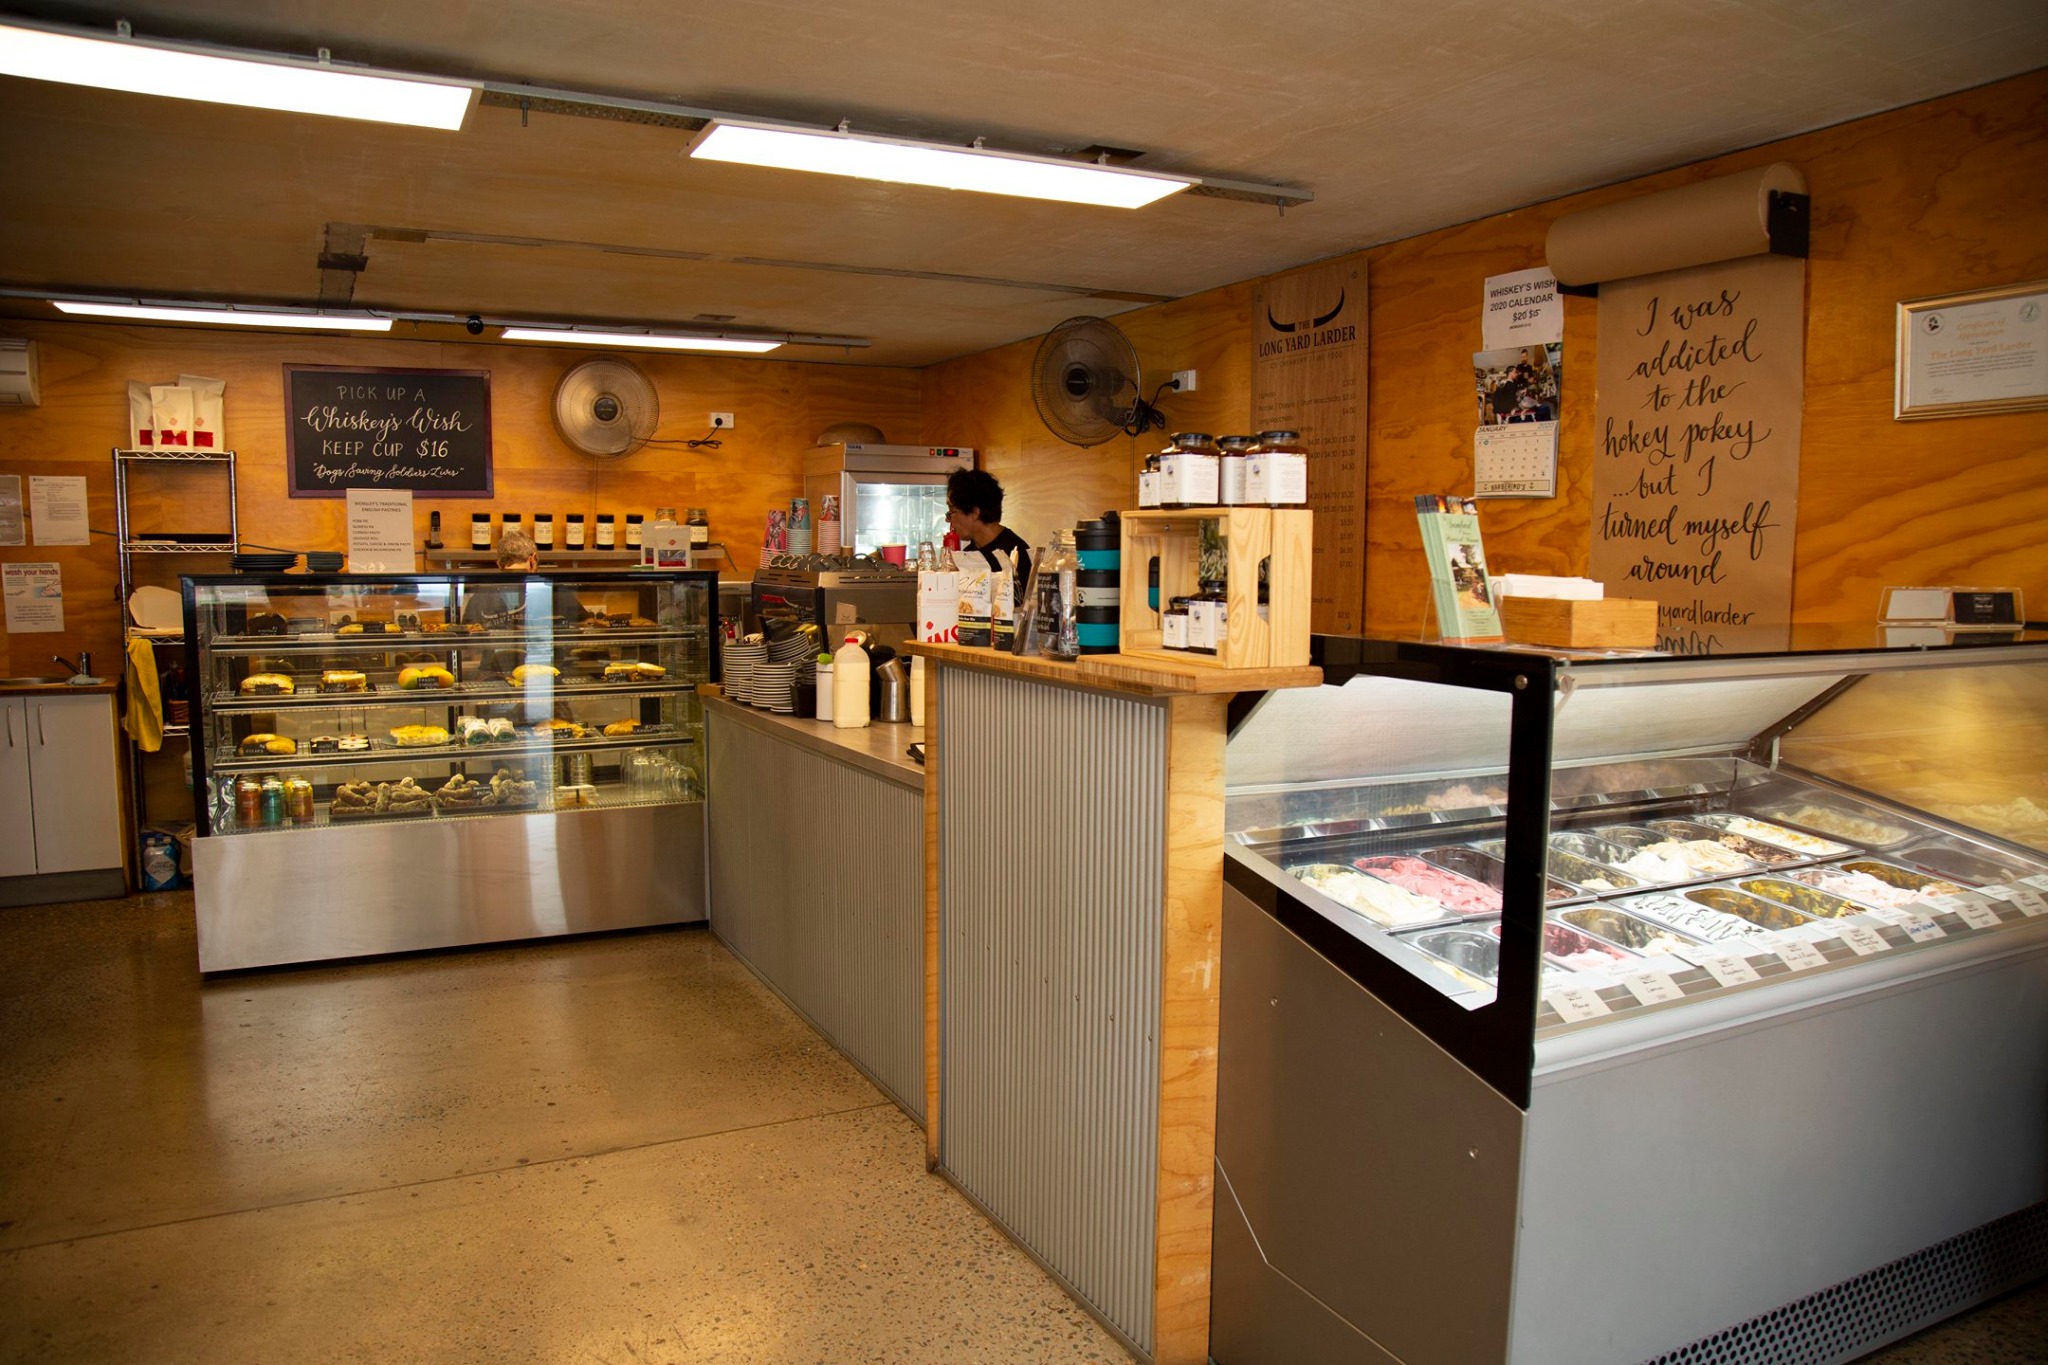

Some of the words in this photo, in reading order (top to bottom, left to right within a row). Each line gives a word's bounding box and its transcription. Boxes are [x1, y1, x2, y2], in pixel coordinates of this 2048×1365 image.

[1490, 282, 1532, 298] WHISKEY'S
[1533, 279, 1556, 290] WISH
[1490, 301, 1507, 312] 2020
[1508, 293, 1553, 308] CALENDAR
[1299, 320, 1310, 331] THE
[1636, 296, 1658, 337] I
[1671, 290, 1740, 331] was
[1259, 339, 1283, 358] LONG
[1285, 333, 1311, 353] YARD
[1313, 325, 1356, 347] LARDER
[1626, 318, 1763, 381] addicted
[336, 385, 378, 402] PICK
[386, 387, 407, 402] UP
[413, 388, 426, 402] A
[1641, 385, 1678, 412] to
[1678, 374, 1747, 410] the
[300, 405, 402, 442] Whiskey's
[405, 404, 473, 434] Wish
[1477, 426, 1508, 434] JANUARY
[1601, 416, 1675, 466] hokey
[1680, 411, 1771, 464] pokey
[322, 439, 364, 456] KEEP
[372, 442, 405, 458] CUP
[416, 438, 449, 460] $16
[344, 462, 385, 483] Saving
[1697, 455, 1715, 496] I
[1598, 502, 1678, 545] turned
[1682, 500, 1780, 561] myself
[1623, 550, 1727, 586] around
